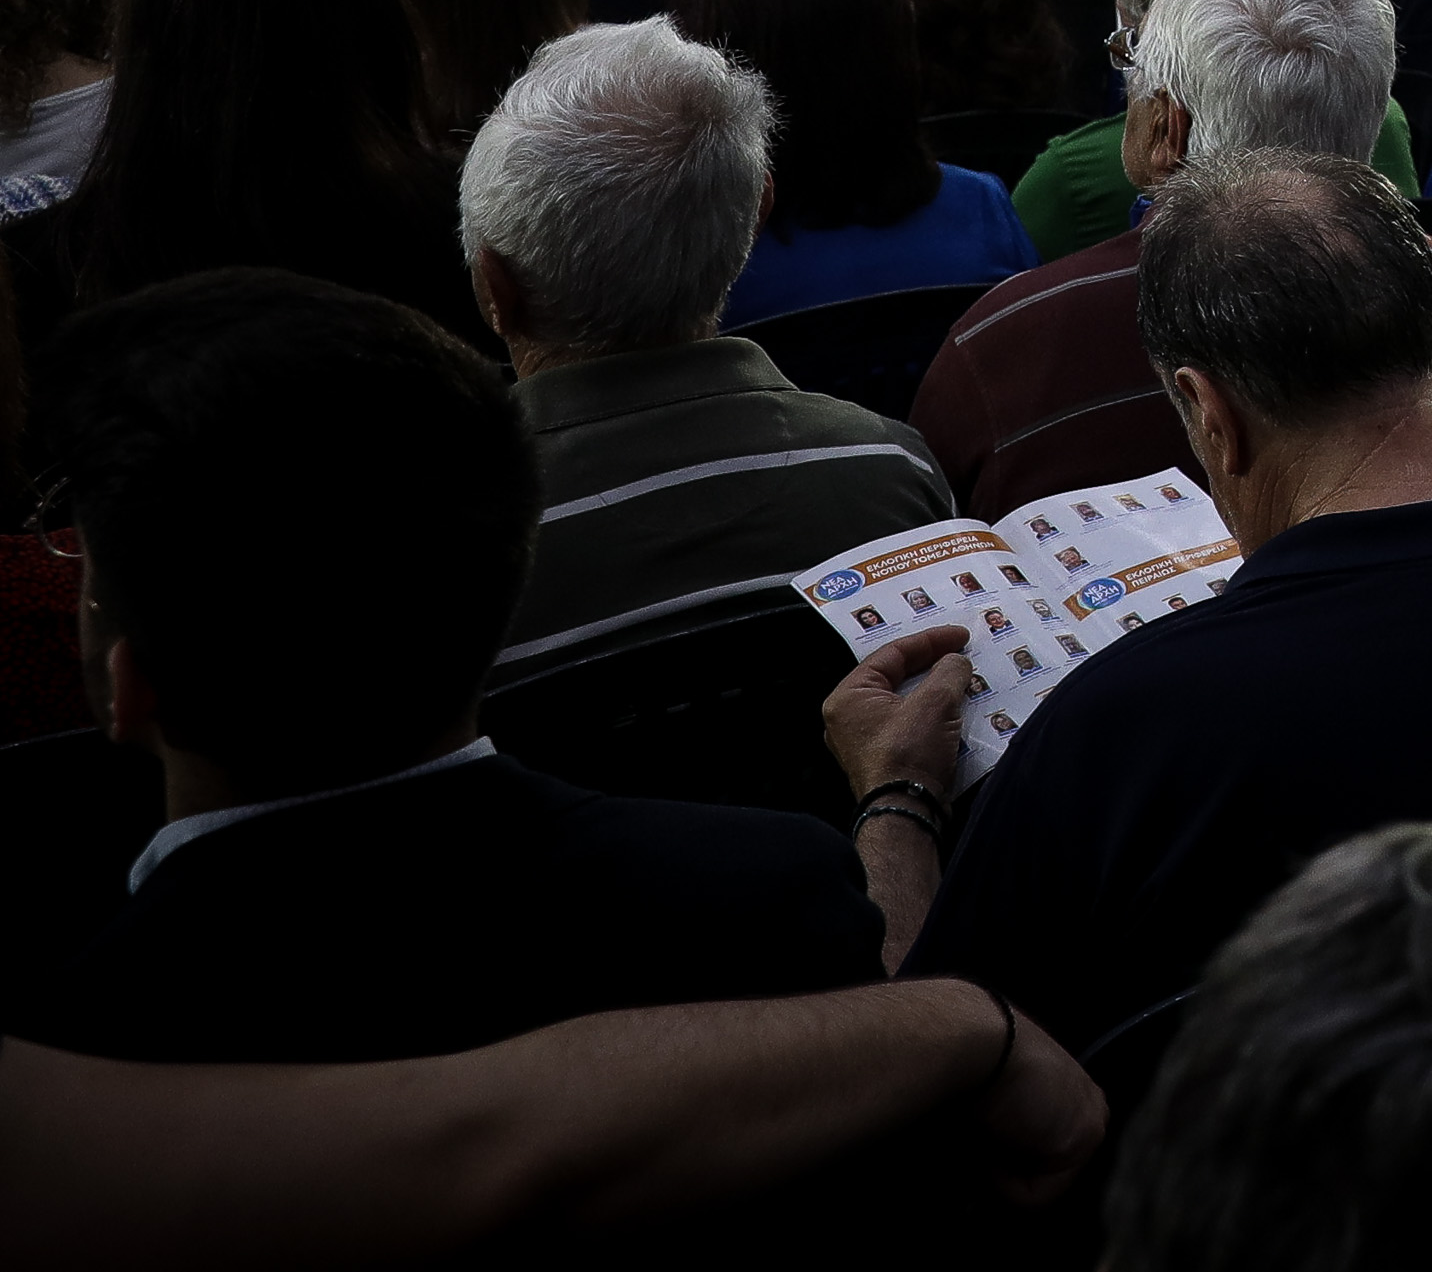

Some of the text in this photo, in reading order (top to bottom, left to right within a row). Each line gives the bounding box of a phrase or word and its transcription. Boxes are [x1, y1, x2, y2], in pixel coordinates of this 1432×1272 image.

[912, 549, 951, 566] ΤΟΜΕΑ
[951, 541, 996, 555] ΑΘΗΝΩΝ
[919, 534, 979, 556] ΠΕΡΙΦΕΡΕΙΑ
[820, 576, 846, 590] ΝΕΑ
[827, 576, 858, 597] ΑΡΧΗ
[1131, 567, 1177, 588] ΠΕΙΡΑΙΩΣ
[1083, 584, 1107, 598] ΝΕΑ
[1091, 585, 1120, 604] ΑΡΧΗ
